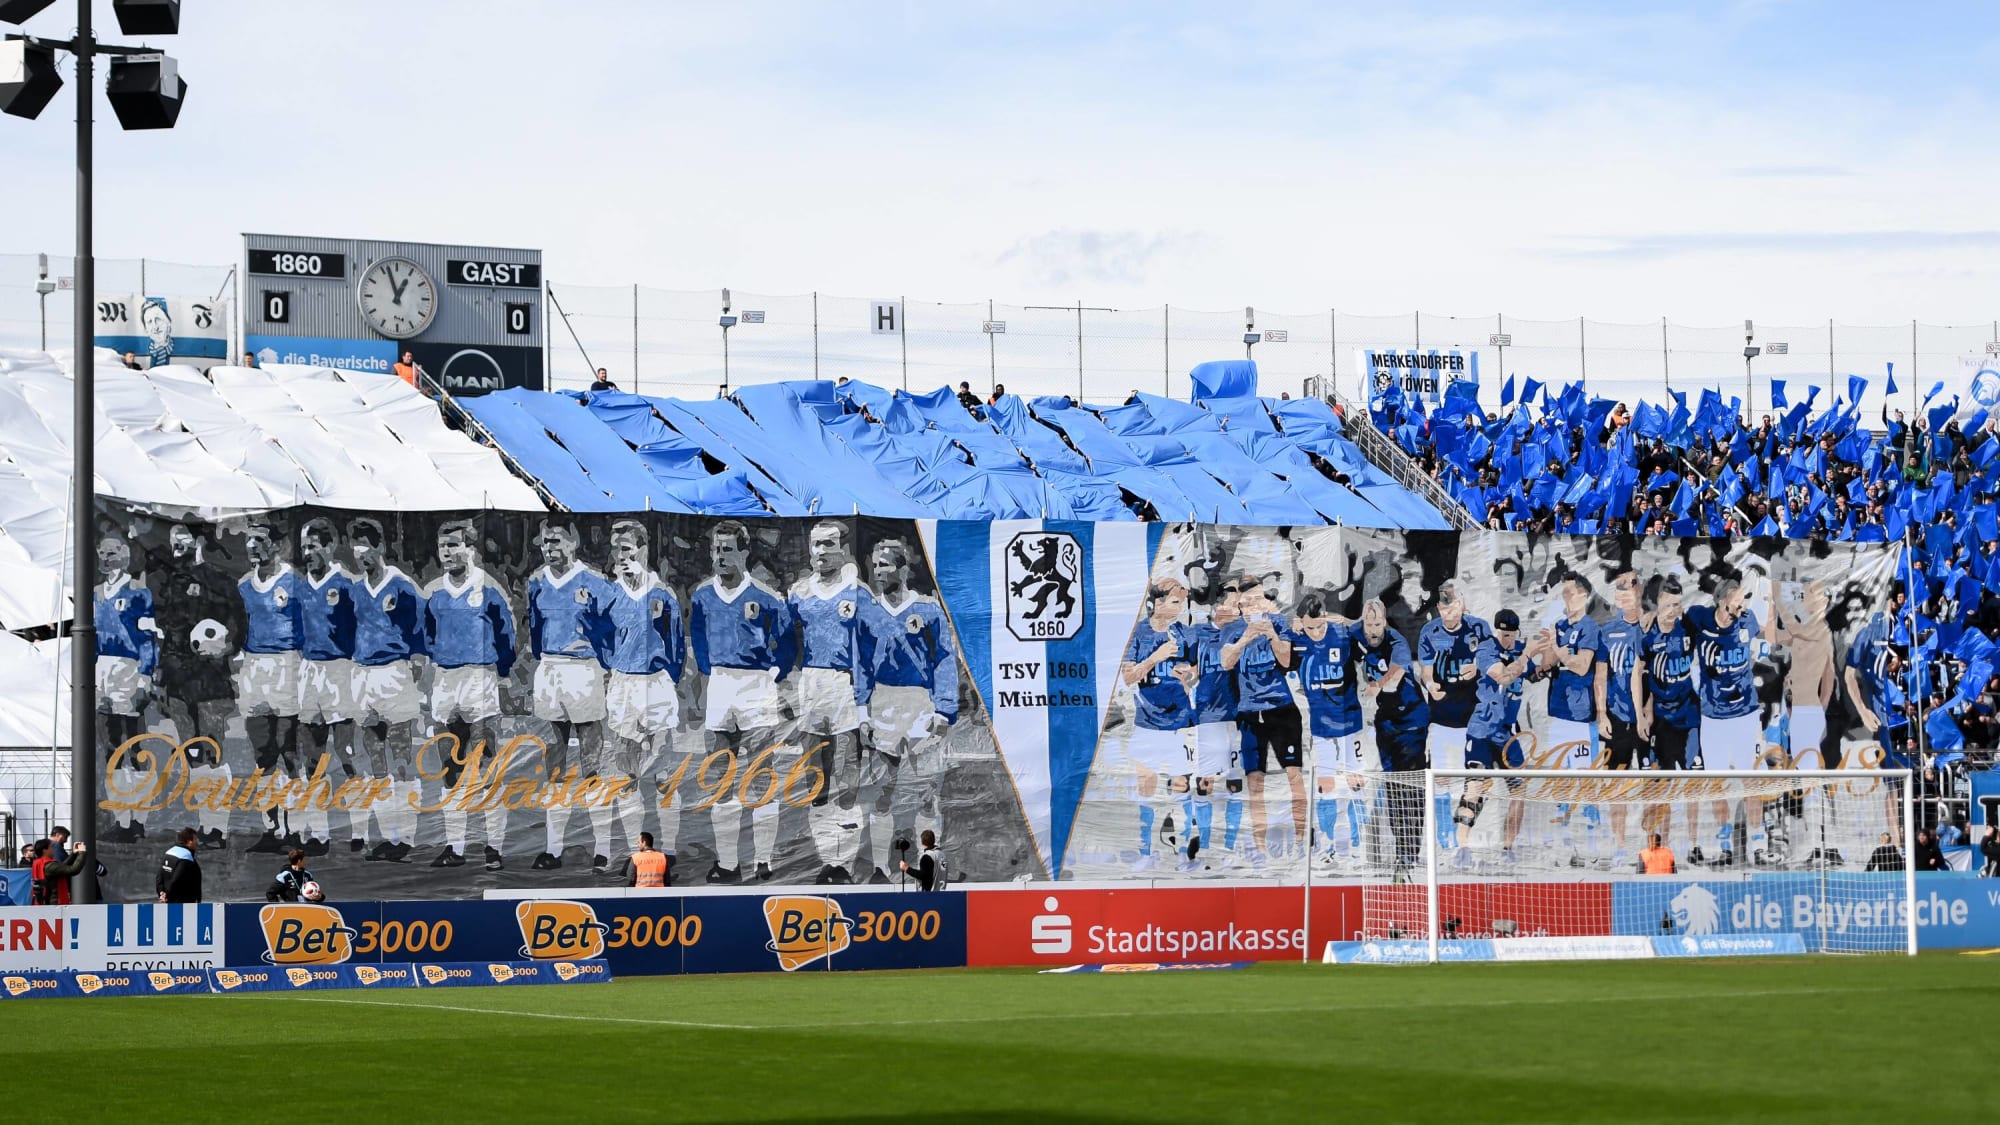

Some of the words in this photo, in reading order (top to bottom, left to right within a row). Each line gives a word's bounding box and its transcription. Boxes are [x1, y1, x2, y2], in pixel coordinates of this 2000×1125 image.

[272, 254, 321, 275] 1860
[462, 262, 524, 284] GAST
[270, 297, 283, 319] 0
[511, 309, 524, 331] 0
[878, 306, 894, 330] H
[283, 353, 306, 365] die
[310, 353, 388, 369] Bayerische
[1371, 353, 1464, 370] MERKENDORFER
[445, 375, 499, 389] MAN
[1029, 621, 1065, 636] 1860
[999, 663, 1040, 680] TSV
[1049, 662, 1089, 679] 1860
[998, 690, 1094, 708] München
[99, 733, 393, 811] Deutscher
[408, 732, 635, 813] Meister
[657, 741, 830, 813] 1966
[1731, 894, 1782, 929] die
[1793, 891, 1968, 934] Bayerische
[0, 918, 80, 951] RN!
[532, 915, 593, 950] Bet
[607, 915, 702, 948] 3000
[778, 910, 838, 943] Bet
[853, 910, 941, 942] 3000
[275, 918, 340, 954] Bet
[355, 920, 453, 953] 3000
[1088, 922, 1306, 958] Stadtsparkasse
[106, 960, 213, 972] RECYCLING
[381, 970, 407, 978] 3000
[447, 969, 471, 977] 3000
[513, 967, 538, 976] 3000
[579, 965, 603, 974] 3000
[103, 977, 130, 986] 3000
[175, 975, 201, 984] 3000
[242, 973, 268, 982] 3000
[312, 971, 338, 980] 3000
[31, 980, 57, 989] 3000
